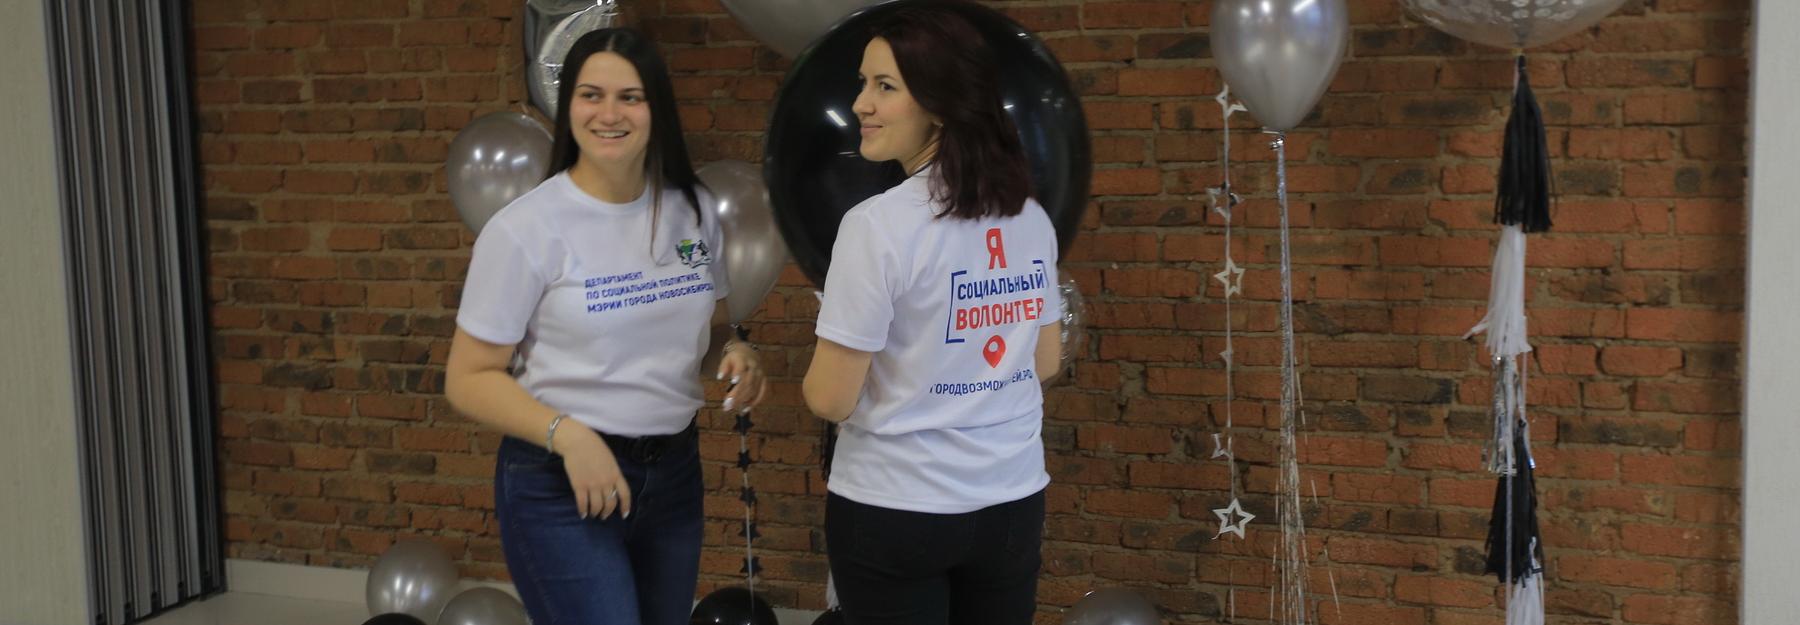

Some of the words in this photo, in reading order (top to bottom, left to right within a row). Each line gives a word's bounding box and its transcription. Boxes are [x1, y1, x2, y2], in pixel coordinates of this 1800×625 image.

[986, 228, 1007, 270] Я
[585, 271, 643, 289] ДЕПАРТАМЕНТ
[586, 289, 599, 301] ПО
[602, 279, 658, 299] СОЦИАЛЬНОЙ
[659, 272, 701, 288] ПОЛИТИКЕ
[957, 269, 1044, 300] СОЦИАЛЬНЫЙ
[587, 300, 623, 313] МЭРИИ
[624, 294, 658, 307] ГОРОДА
[955, 297, 1045, 331] ВОЛОНТЕР
